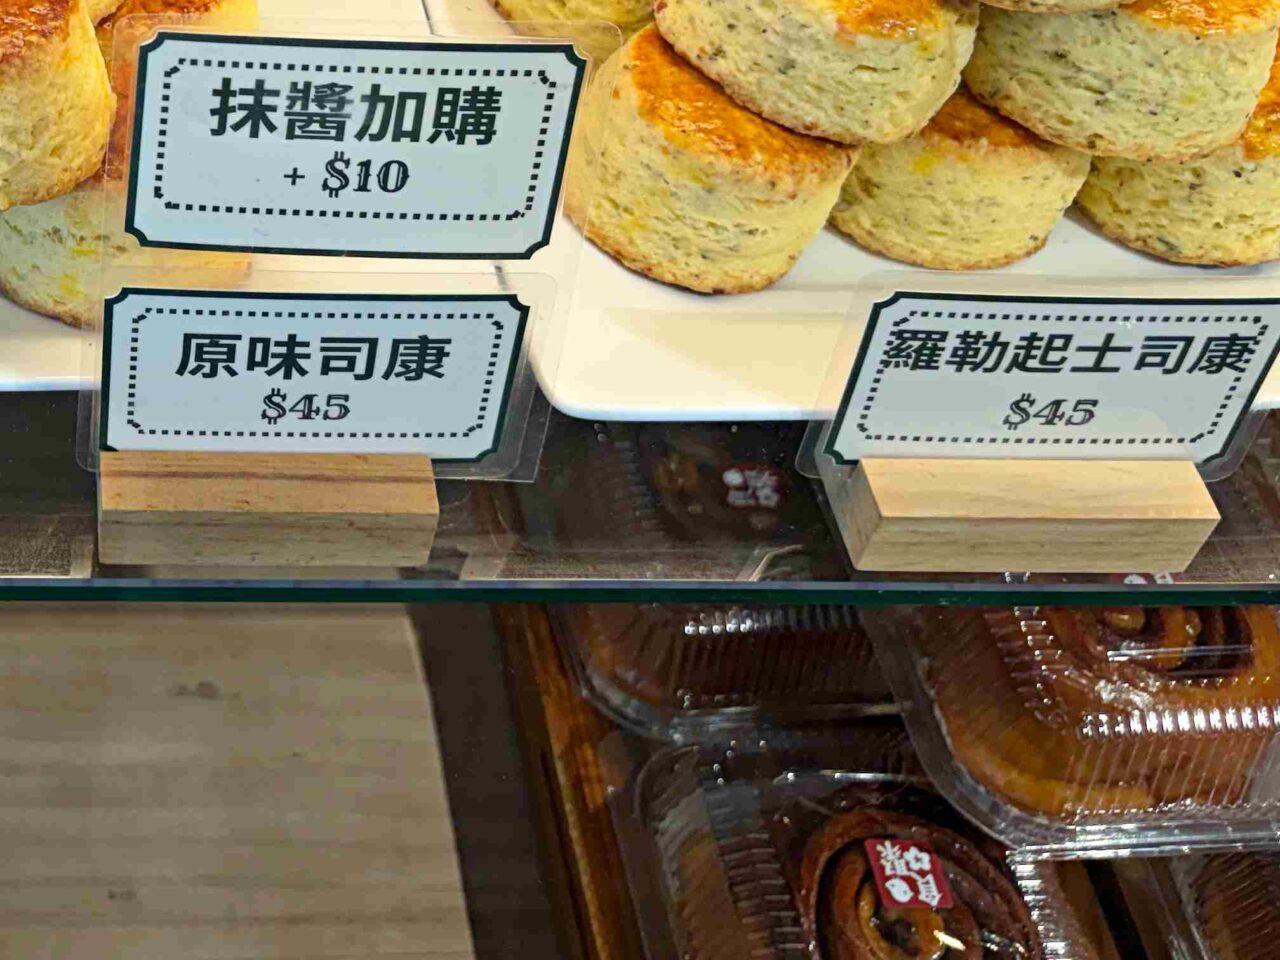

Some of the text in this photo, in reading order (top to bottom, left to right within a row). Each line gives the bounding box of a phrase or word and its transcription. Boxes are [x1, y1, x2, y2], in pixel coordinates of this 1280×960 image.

[209, 78, 502, 146] 抹醬加購
[322, 151, 410, 198] $10
[175, 332, 452, 381] 原味司康
[884, 329, 1258, 375] 羅勒起士司康
[261, 388, 350, 424] $45
[1003, 393, 1099, 431] $45
